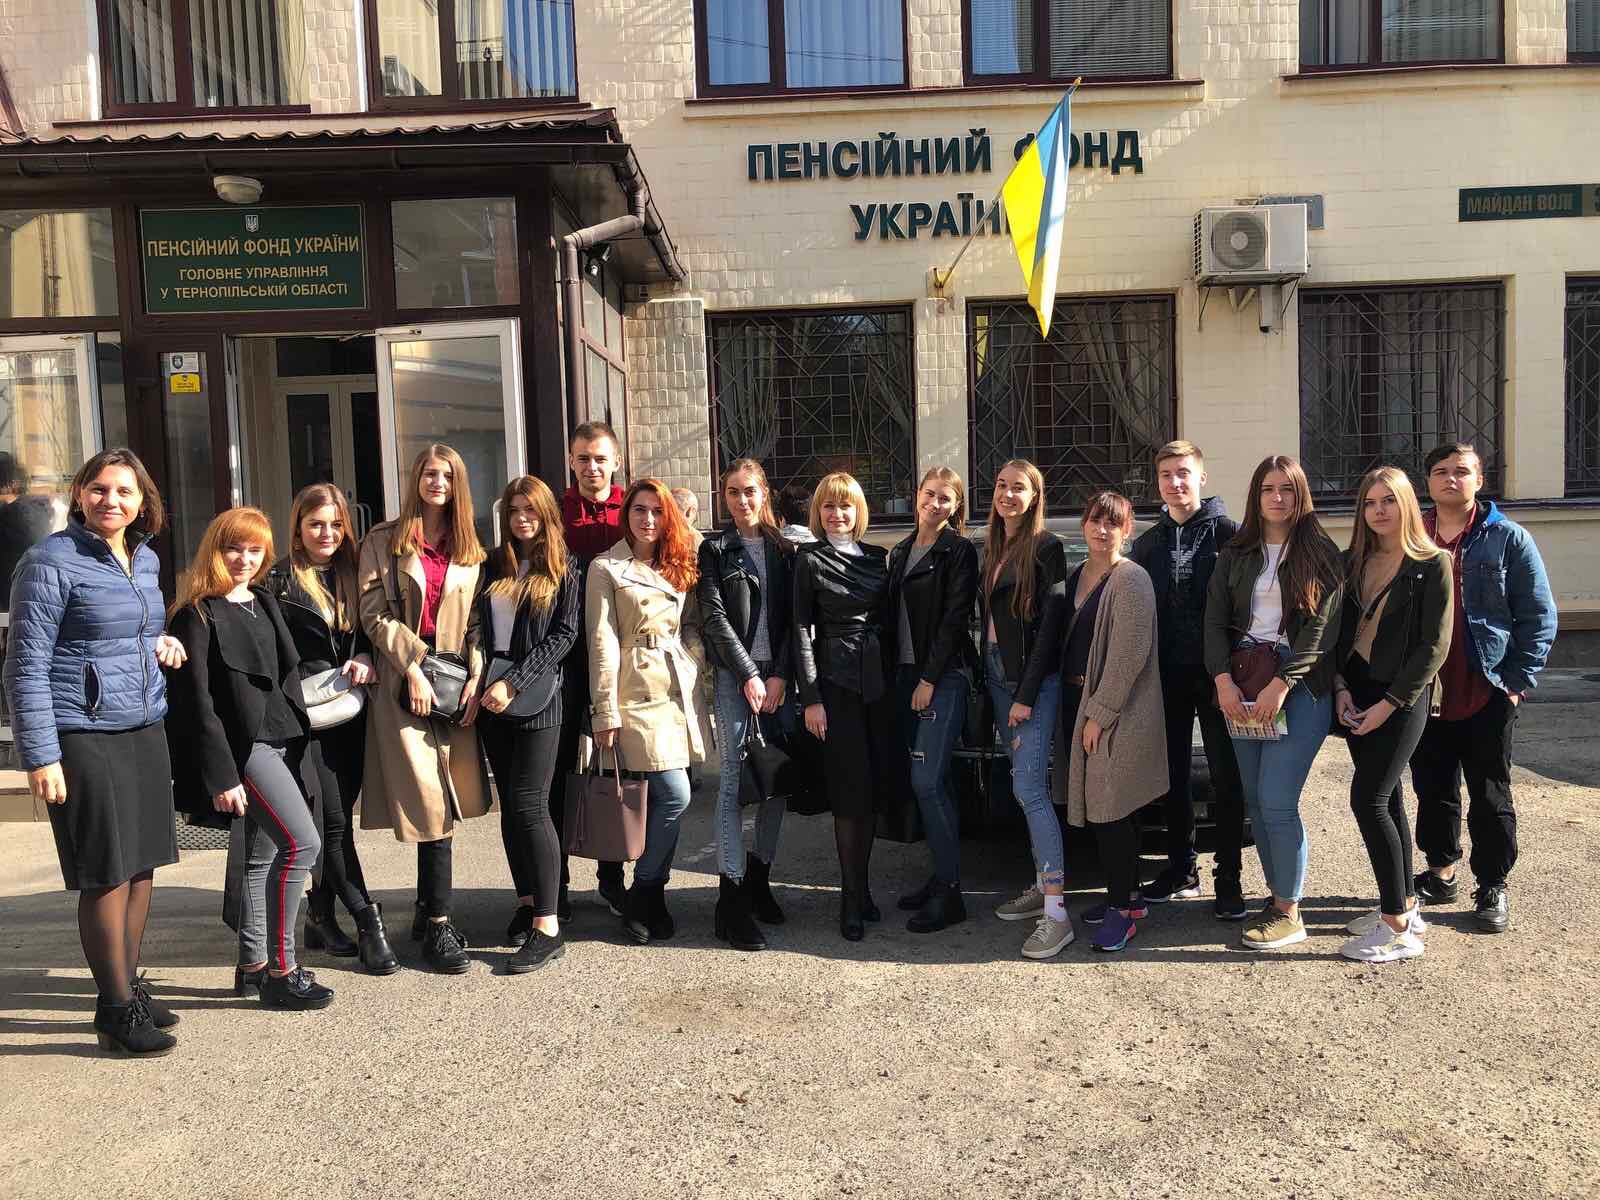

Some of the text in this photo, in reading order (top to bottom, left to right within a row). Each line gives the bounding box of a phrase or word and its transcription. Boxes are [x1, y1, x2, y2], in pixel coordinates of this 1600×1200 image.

[748, 128, 991, 181] ПЕНСІЙНИЙ
[1466, 191, 1533, 215] МАЙДАН
[849, 193, 1013, 241] УКРАЇН
[147, 233, 359, 257] ПЕНСІЙНИЙ ФОНД УКРАЇНИ
[179, 264, 328, 281] ГОЛОВНЕ УПРАВЛІННЯ
[160, 282, 348, 299] У ТЕРНОПІЛЬСЬКІЙ ОБЛАСТІ
